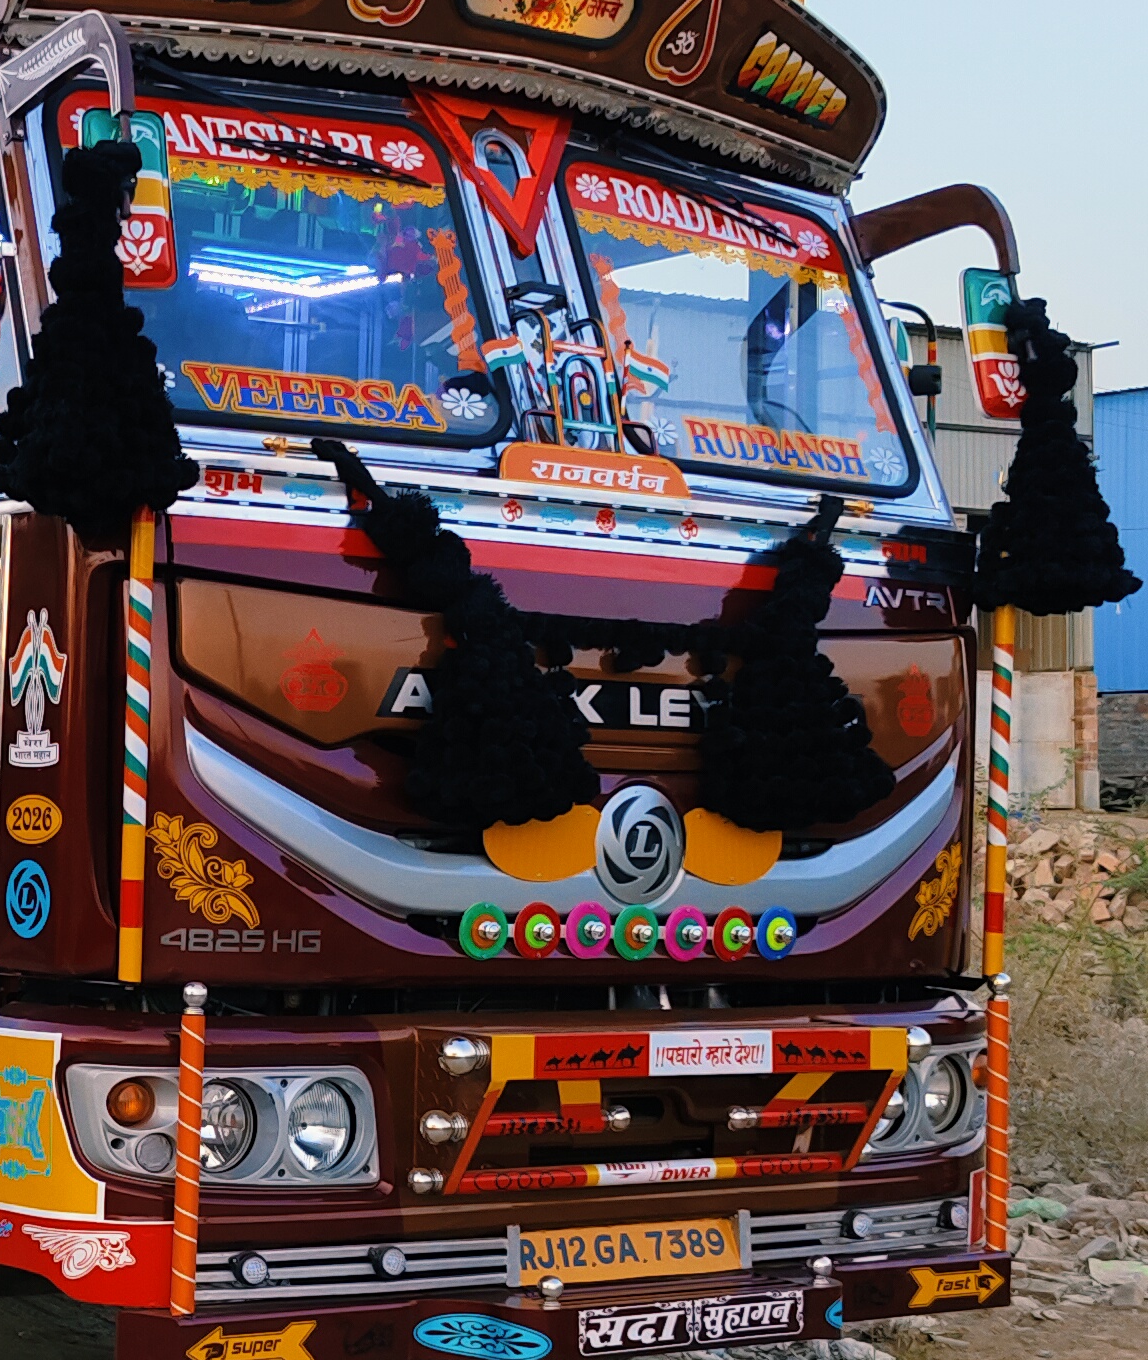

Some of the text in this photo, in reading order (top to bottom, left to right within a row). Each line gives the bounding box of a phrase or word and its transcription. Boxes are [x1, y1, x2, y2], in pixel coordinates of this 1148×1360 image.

[181, 360, 448, 432] VEERSA
[682, 415, 870, 479] RUDRANSH
[531, 455, 669, 496] राजवर्धन
[866, 586, 947, 614] AVTR
[12, 806, 52, 831] 2026
[160, 928, 321, 953] 4825 HG
[936, 1276, 972, 1293] fast
[585, 1298, 794, 1350] सदा सुहागन
[231, 1337, 282, 1358] super
